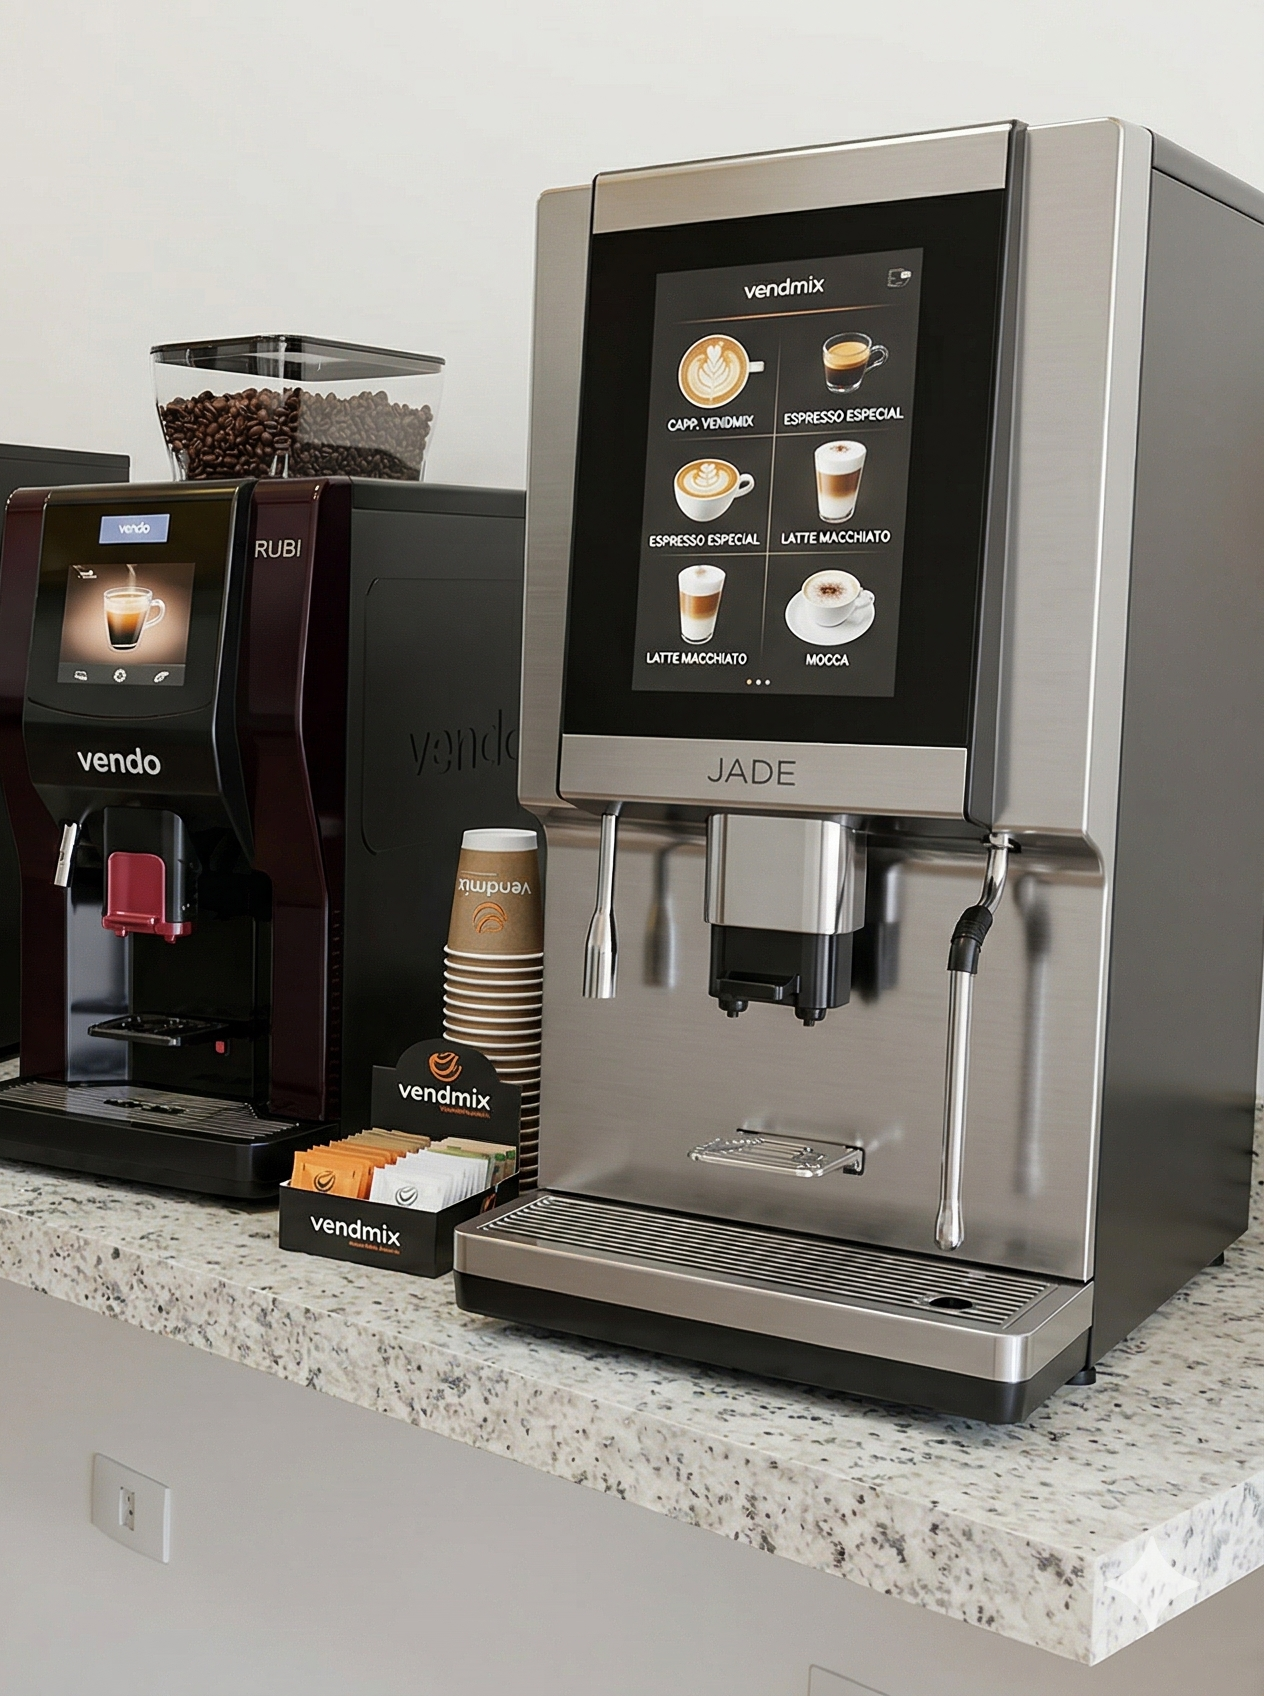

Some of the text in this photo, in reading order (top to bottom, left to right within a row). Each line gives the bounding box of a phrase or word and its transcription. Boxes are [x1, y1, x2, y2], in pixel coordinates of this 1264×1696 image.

[744, 275, 825, 299] vendmix
[667, 415, 754, 432] CAPP. VENDMIX
[783, 406, 904, 426] ESPRESSO ESPECIAL
[118, 521, 151, 534] vendo
[781, 529, 891, 545] LATTE MACCHIATO
[254, 539, 302, 558] RUBI
[649, 532, 761, 548] ESPRESSO ESPECIAL
[646, 651, 748, 665] LATTE MACCHIATO
[805, 653, 850, 667] MOCCA
[77, 747, 161, 775] vendo
[707, 757, 797, 786] JADE
[458, 878, 532, 897] vendmix
[398, 1083, 490, 1111] vendmix
[310, 1216, 401, 1247] vendmix
